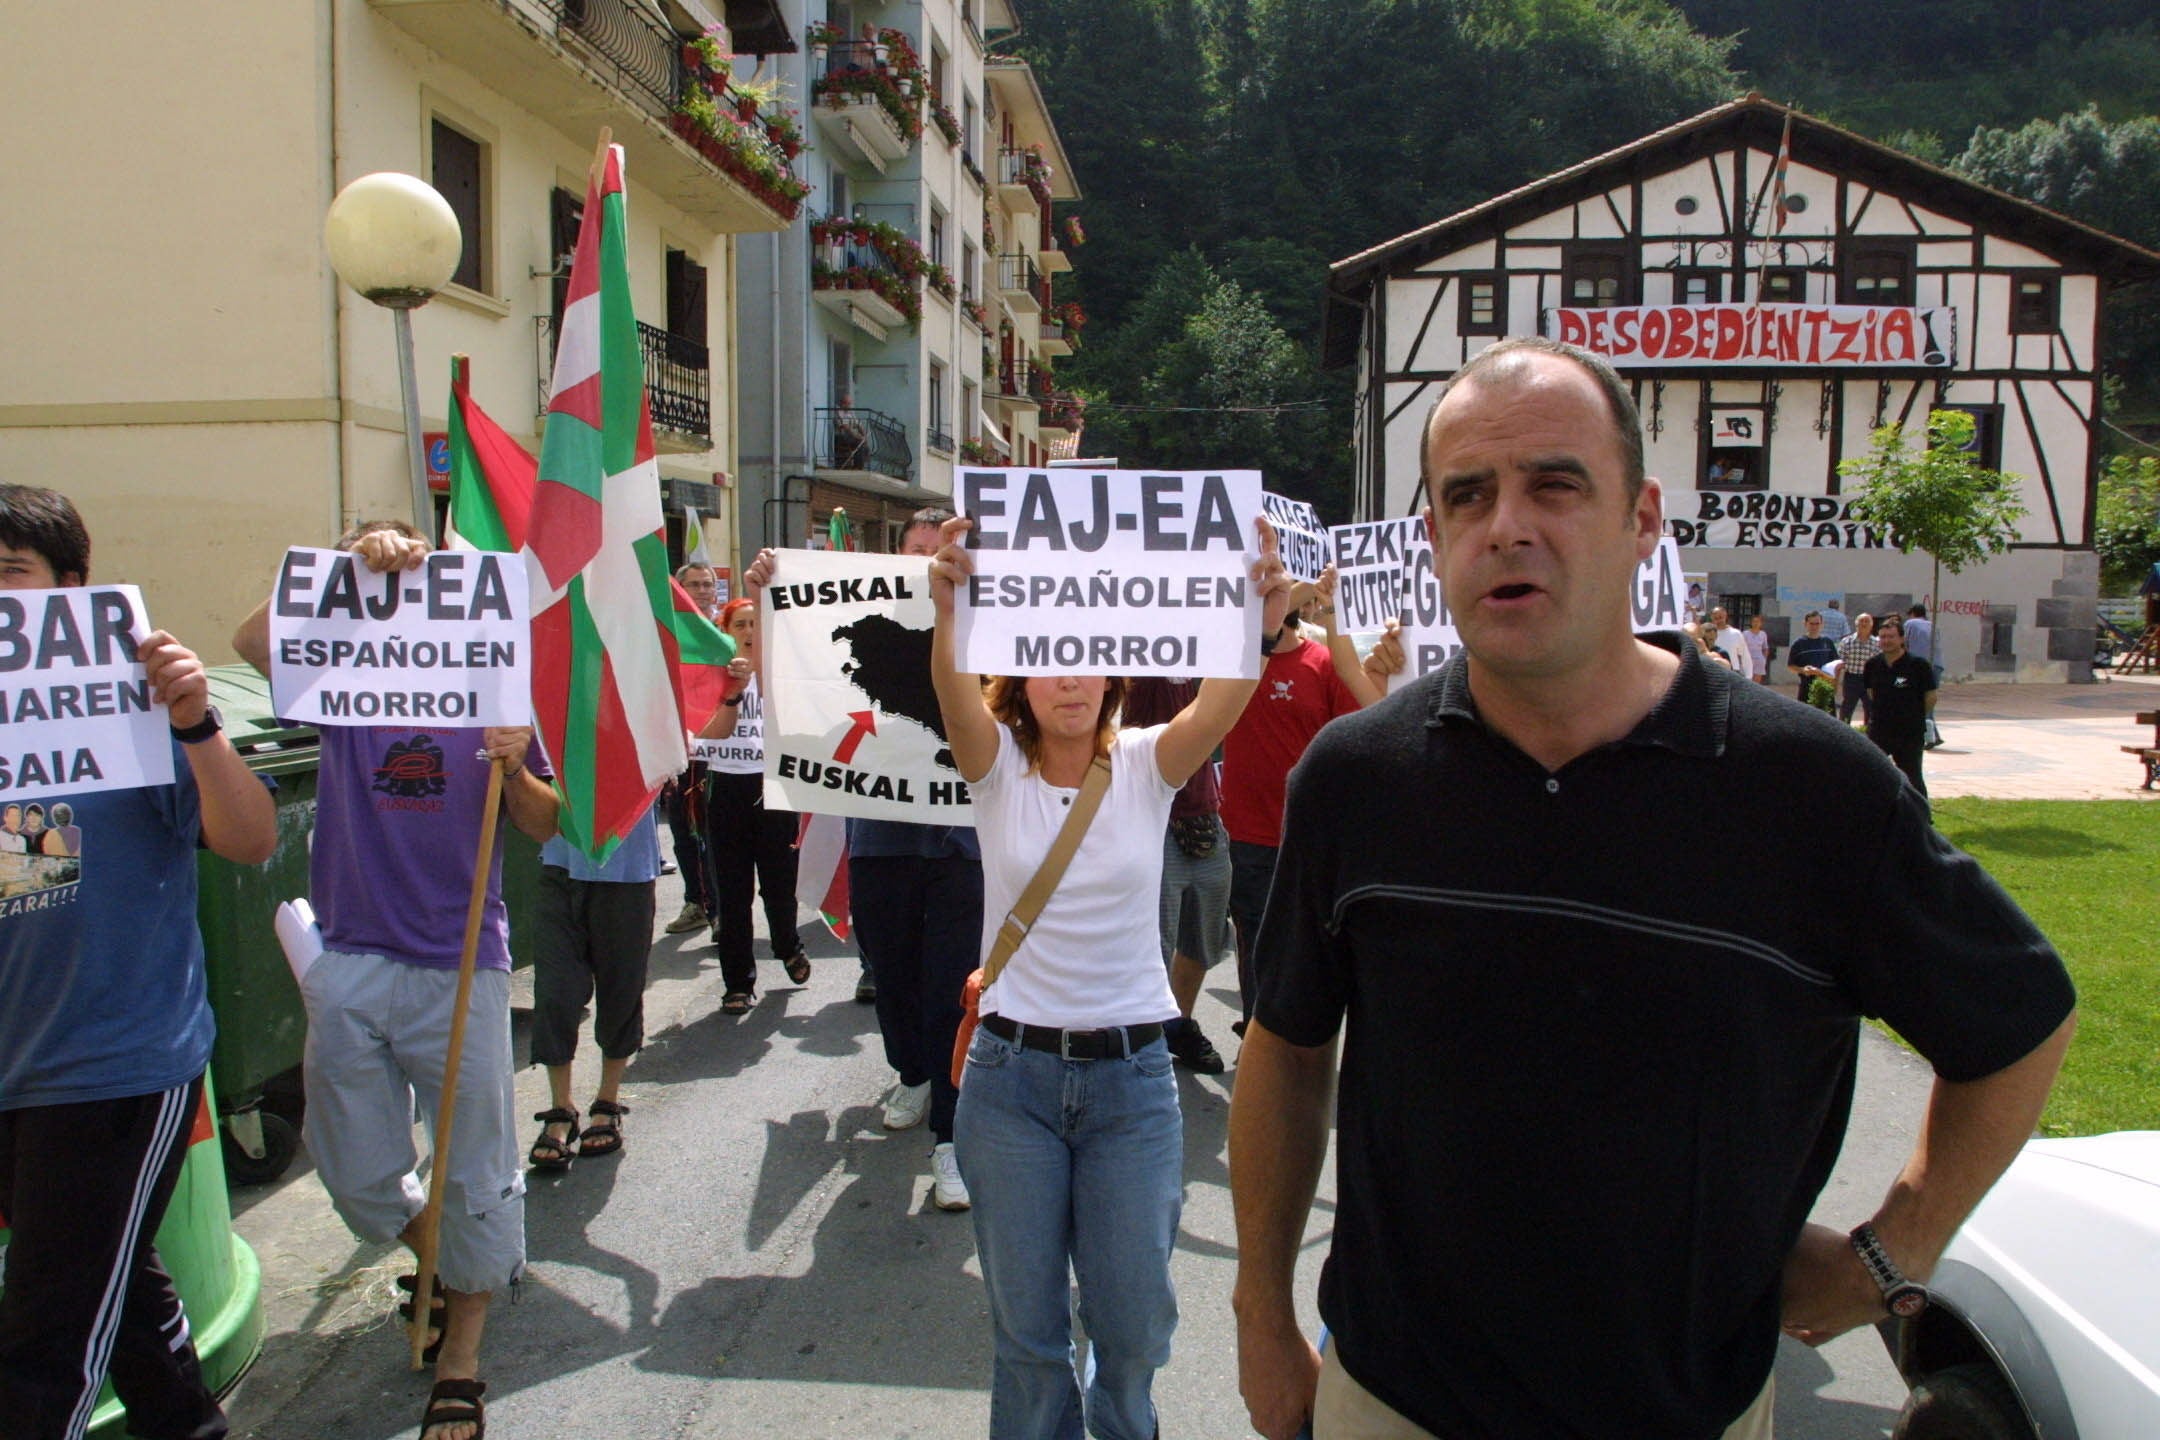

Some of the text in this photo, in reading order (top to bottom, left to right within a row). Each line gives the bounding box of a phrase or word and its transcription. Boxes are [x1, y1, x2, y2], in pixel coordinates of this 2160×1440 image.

[963, 472, 1245, 552] EAJ-EA
[277, 550, 512, 621] EAJ-EA
[769, 575, 913, 611] EUSKAL
[969, 569, 1245, 608] ESPAÑOLEN
[280, 635, 515, 668] ESPAÑOLEN
[1014, 635, 1197, 667] MORROI
[320, 690, 478, 719] MORROI
[778, 753, 914, 804] EUSKAL
